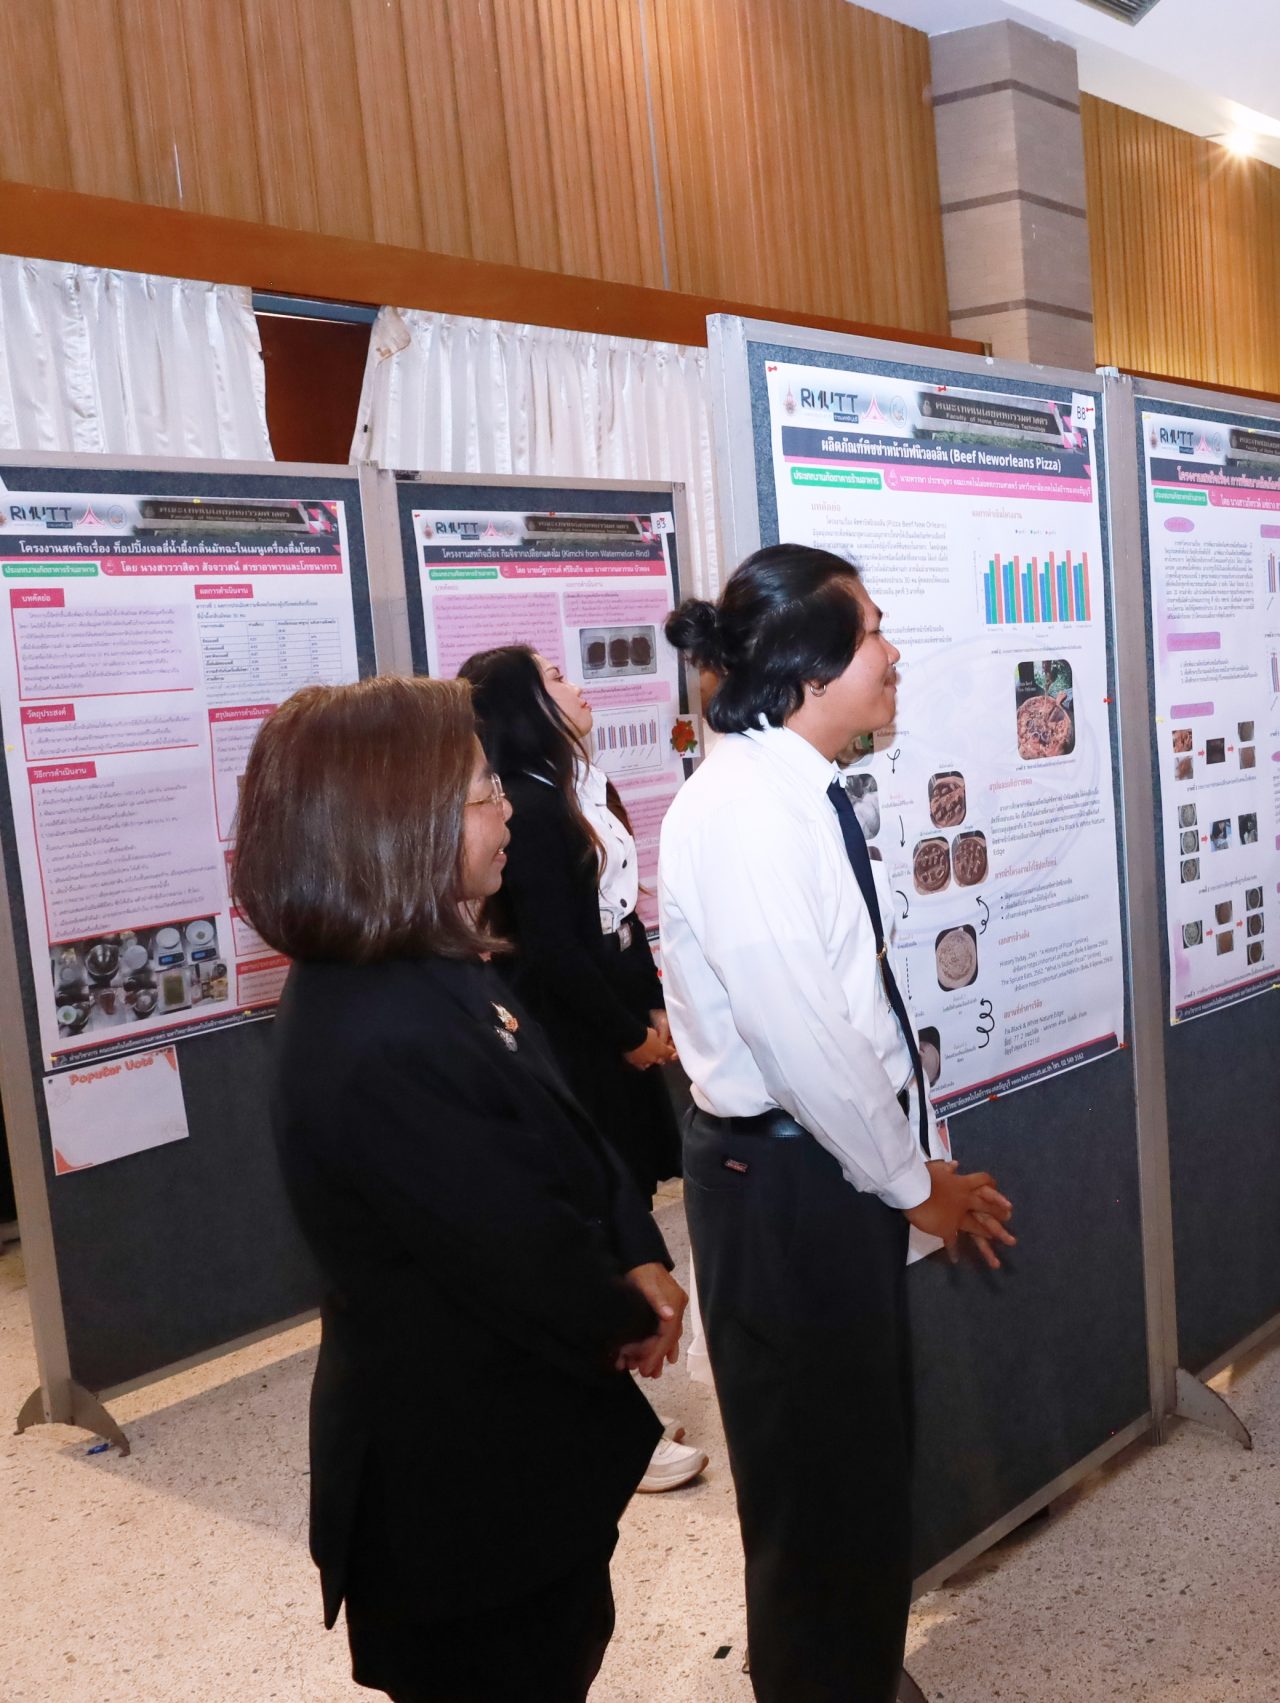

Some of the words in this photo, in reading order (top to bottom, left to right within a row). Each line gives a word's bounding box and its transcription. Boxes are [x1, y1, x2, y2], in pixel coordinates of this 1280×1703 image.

[800, 388, 858, 413] RMUTT
[1076, 405, 1087, 421] B8
[946, 413, 967, 421] Faculty
[977, 417, 992, 425] Home
[993, 419, 1020, 429] Economics
[1021, 423, 1046, 433] Technology
[1160, 428, 1194, 446] RMUTT
[950, 449, 976, 464] (Beef
[978, 451, 1035, 469] Neworleans
[1036, 457, 1061, 472] Pizza)
[10, 505, 72, 520] RMUTT
[435, 521, 479, 534] RMUTT
[19, 539, 110, 553] โครงงานสหกิจเรื่อง
[562, 549, 584, 558] (Kimchi
[635, 549, 650, 558] Rind)
[121, 561, 138, 572] โดย
[69, 1064, 122, 1086] Popular
[125, 1057, 154, 1071] Vote
